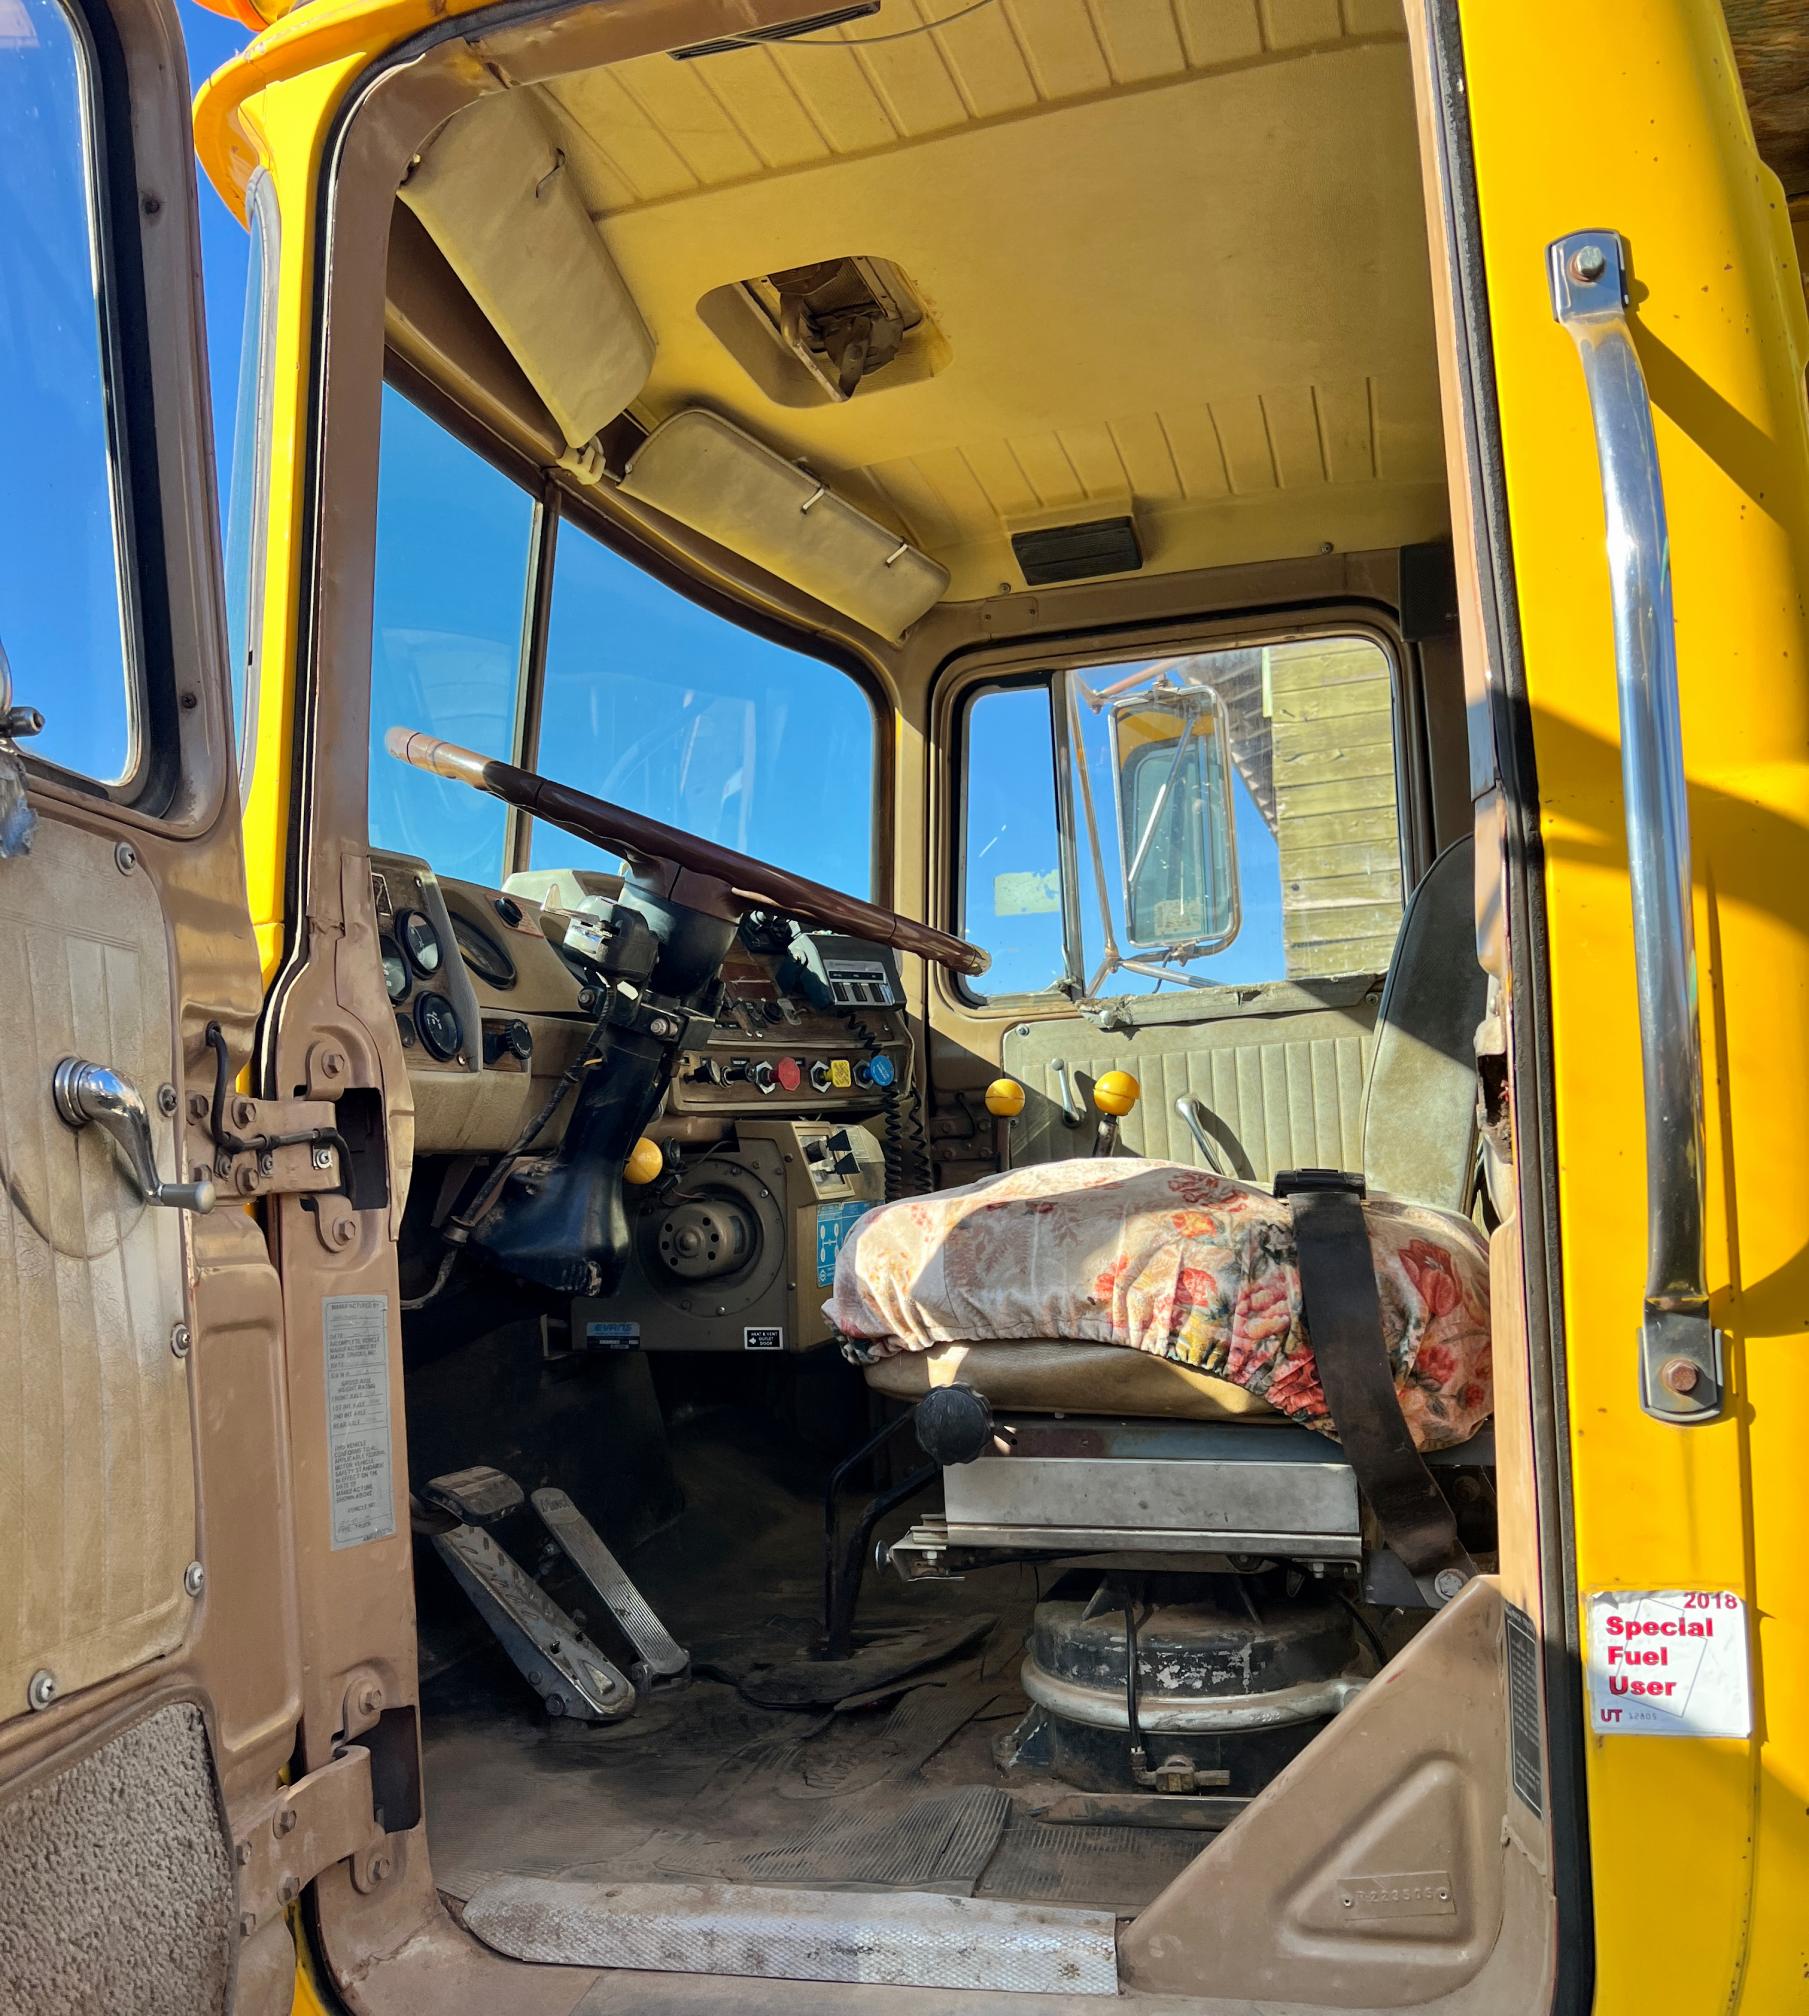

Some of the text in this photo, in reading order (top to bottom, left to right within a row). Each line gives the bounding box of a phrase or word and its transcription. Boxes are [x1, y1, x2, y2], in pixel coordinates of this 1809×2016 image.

[1684, 1592, 1737, 1609] 2018
[1606, 1616, 1713, 1640] Special
[1608, 1646, 1668, 1665] Fuel
[1609, 1676, 1677, 1695] User
[1601, 1709, 1622, 1722] UT
